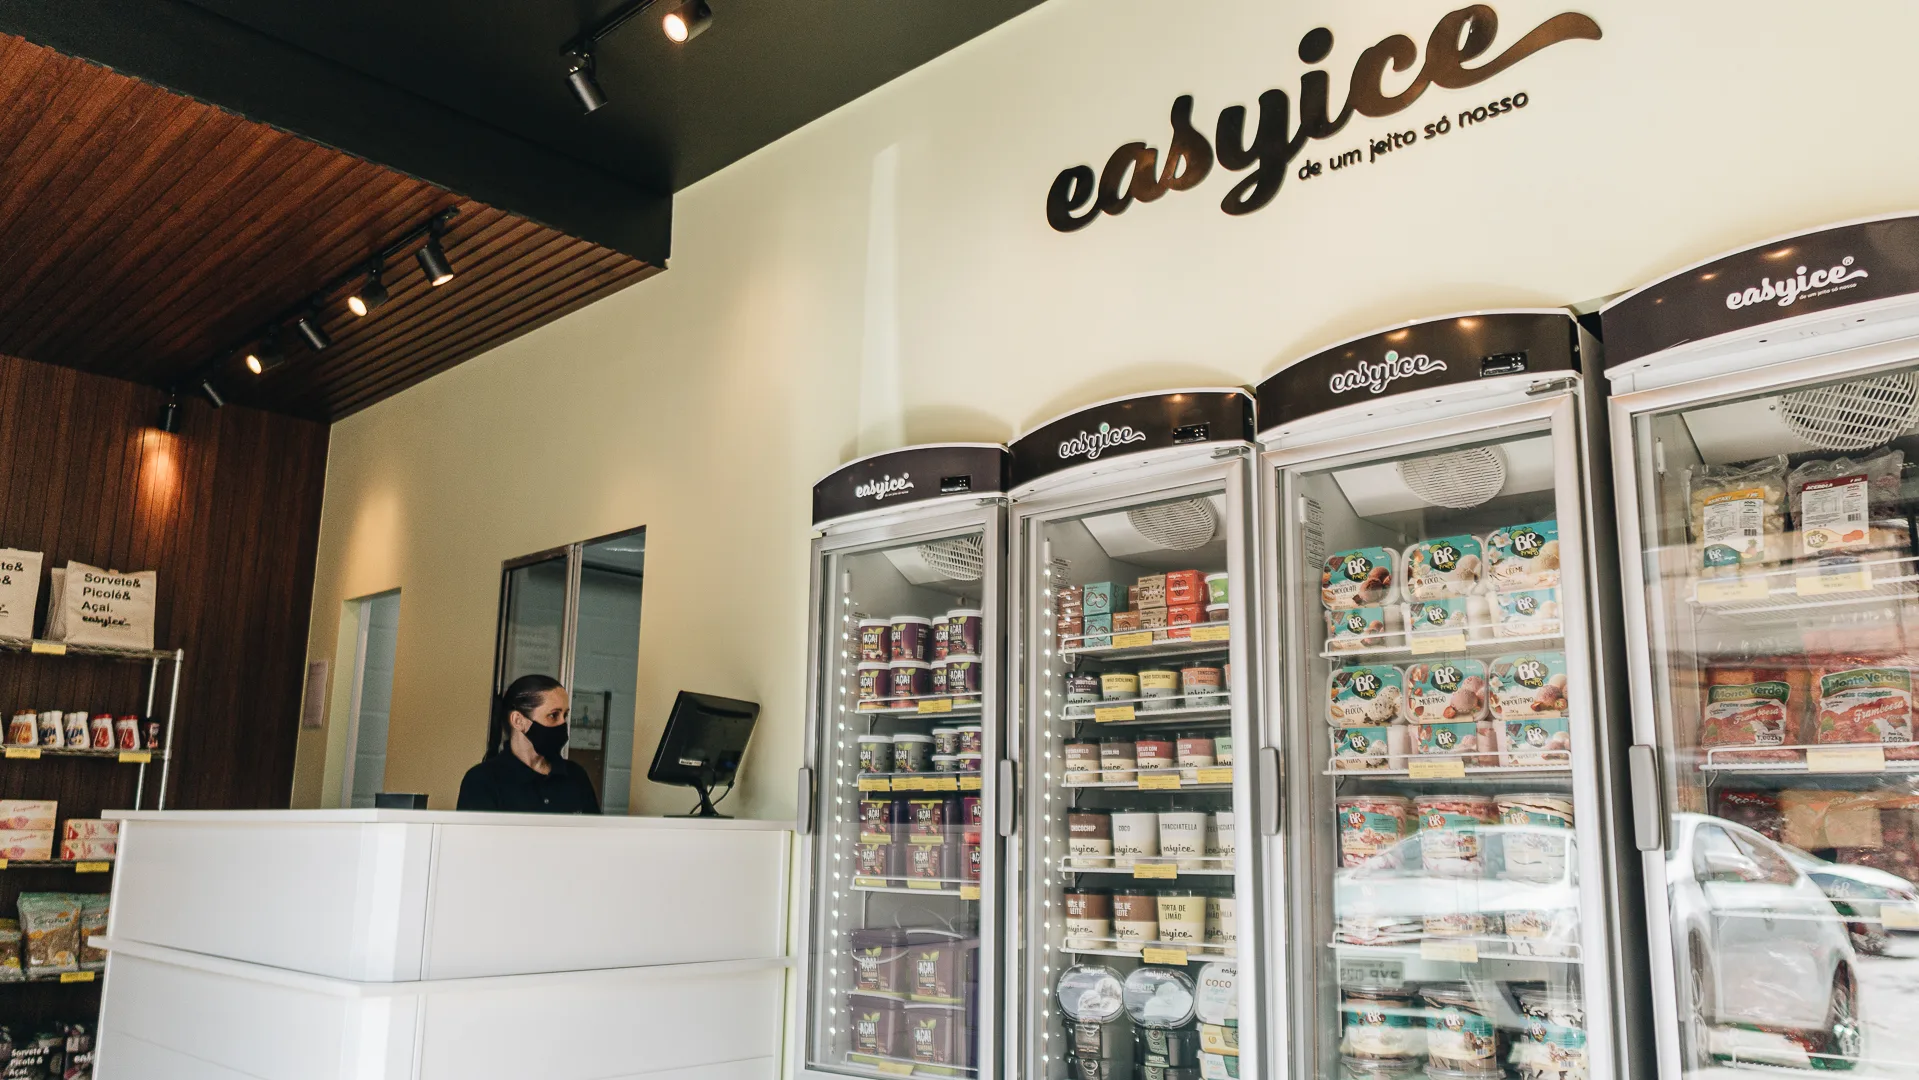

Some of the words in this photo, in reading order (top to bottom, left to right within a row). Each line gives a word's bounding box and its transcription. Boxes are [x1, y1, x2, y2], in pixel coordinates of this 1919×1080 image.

[1046, 4, 1603, 233] easyice
[1298, 159, 1322, 181] de
[1329, 148, 1363, 171] um
[1368, 137, 1418, 164] jeito
[1423, 115, 1452, 141] só
[1458, 91, 1530, 128] nosso
[1329, 350, 1447, 394] easyice
[1059, 422, 1146, 459] easyice
[1515, 534, 1536, 552] BR
[1808, 533, 1824, 546] BR
[1433, 547, 1455, 565] BR
[1707, 548, 1722, 561] BR
[1348, 559, 1366, 574] BR
[1424, 576, 1439, 585] COCO
[1435, 667, 1455, 685] BR
[1518, 663, 1540, 680] BR
[1830, 677, 1865, 688] Monte
[1867, 671, 1901, 683] Verde
[1356, 675, 1374, 692] BR
[1714, 689, 1748, 699] Monte
[1750, 685, 1783, 695] Verde
[1853, 700, 1904, 723] Framboesa
[1205, 978, 1231, 989] COCO
